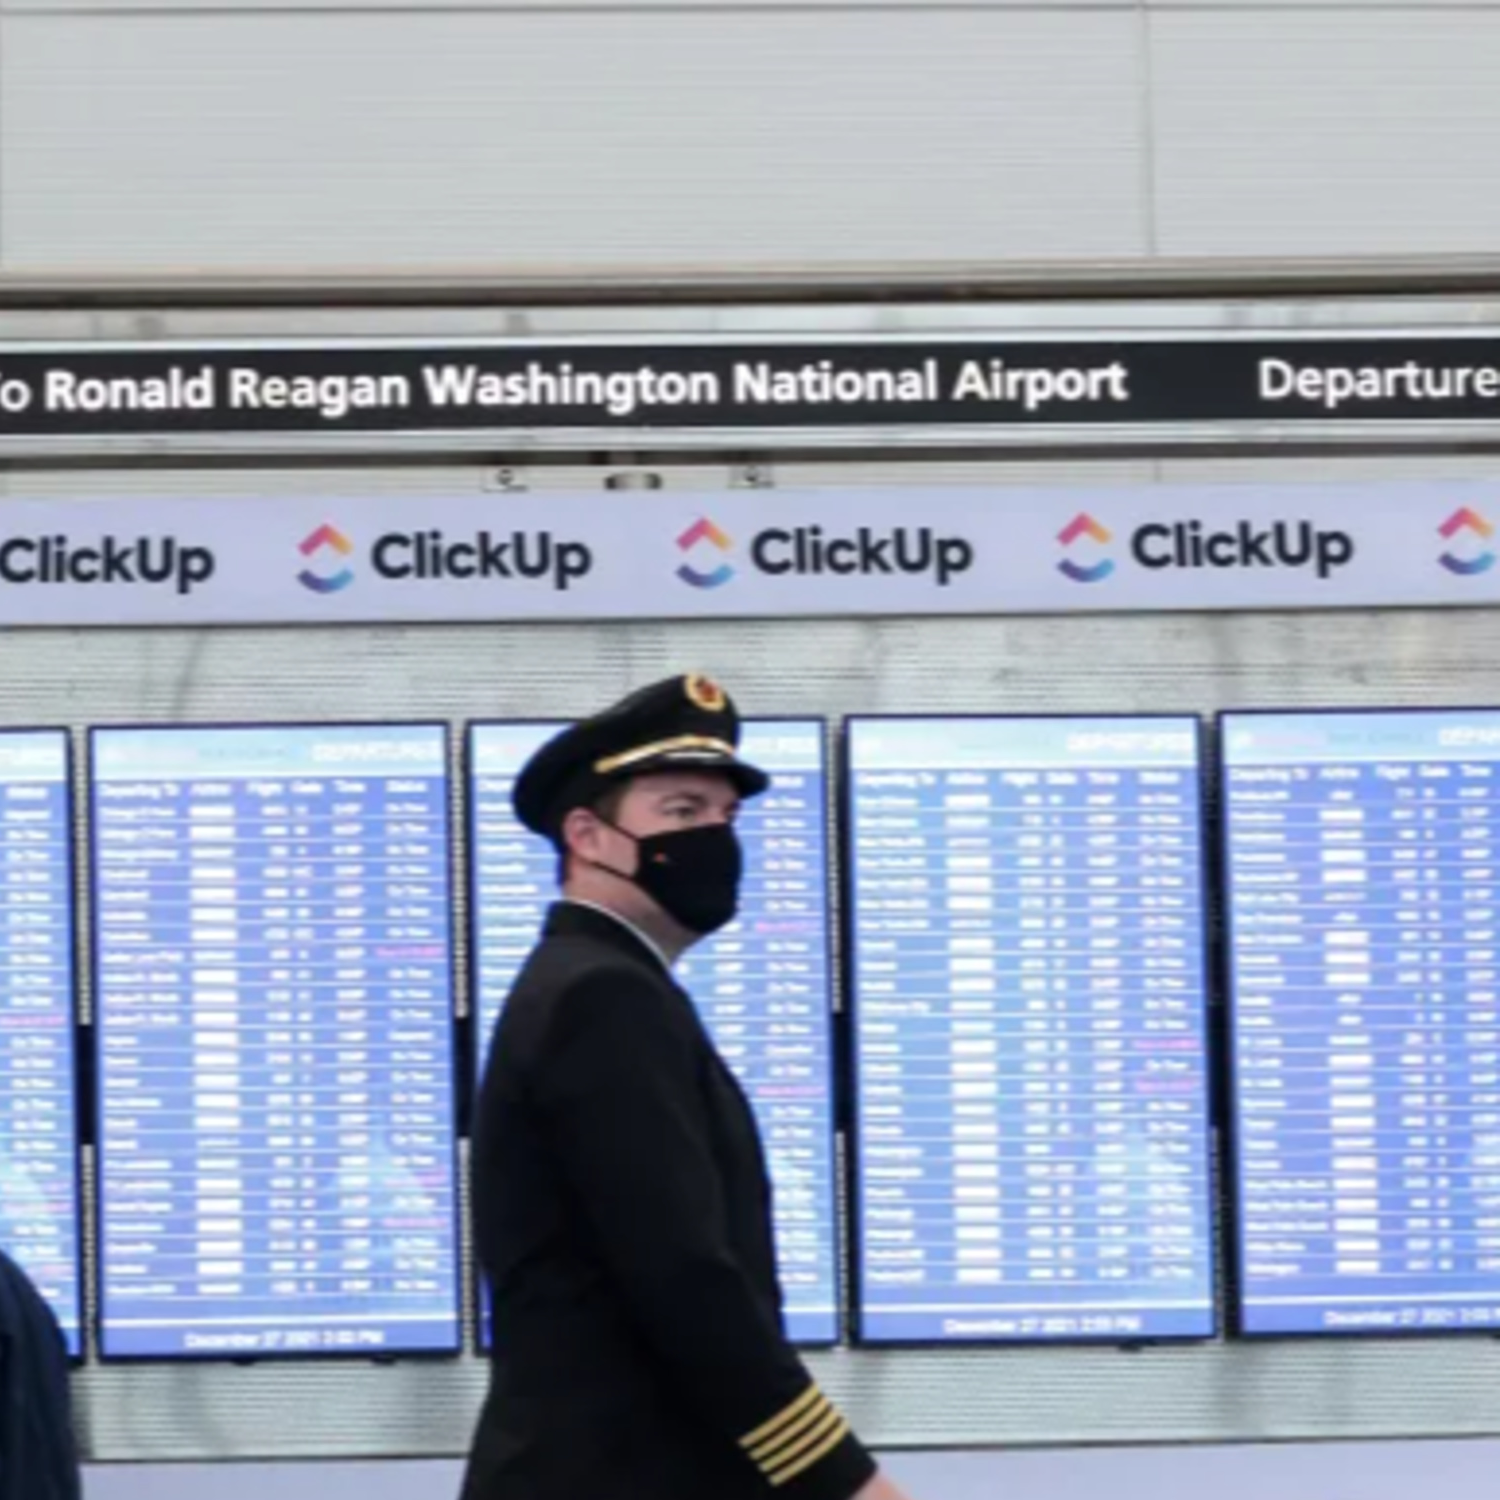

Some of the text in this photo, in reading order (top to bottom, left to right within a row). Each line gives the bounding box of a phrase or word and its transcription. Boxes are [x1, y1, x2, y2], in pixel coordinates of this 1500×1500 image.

[44, 366, 214, 411] Ronald
[230, 368, 410, 418] Reagan
[422, 362, 719, 416] Washington
[733, 359, 938, 404] National
[953, 358, 1129, 412] Airport
[371, 530, 592, 591] ClickUp
[751, 525, 973, 586] ClickUp
[1131, 519, 1353, 579] ClickUp
